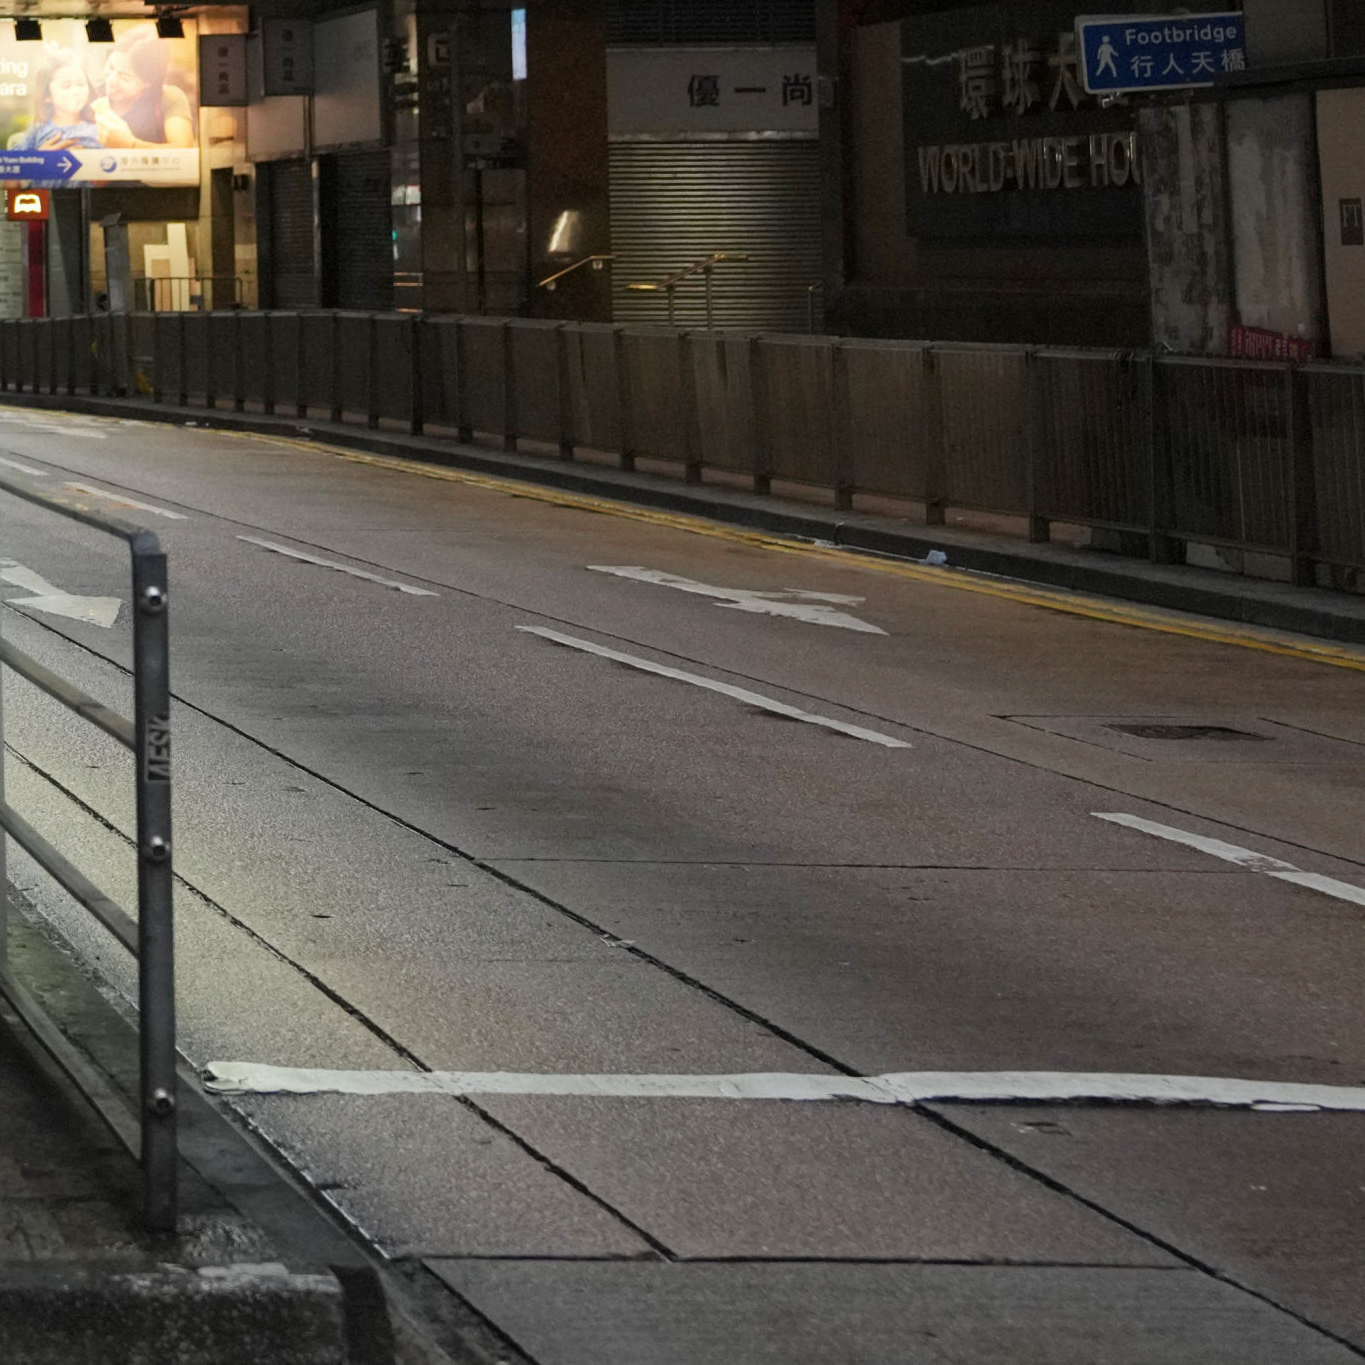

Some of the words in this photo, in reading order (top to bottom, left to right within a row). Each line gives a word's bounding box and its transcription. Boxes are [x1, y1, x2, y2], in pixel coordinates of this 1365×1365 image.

[1126, 23, 1237, 47] Footbridge
[958, 33, 1130, 121] 環球大
[1130, 48, 1246, 78] 行人天橋
[917, 134, 1079, 195] WORLD-WIDE
